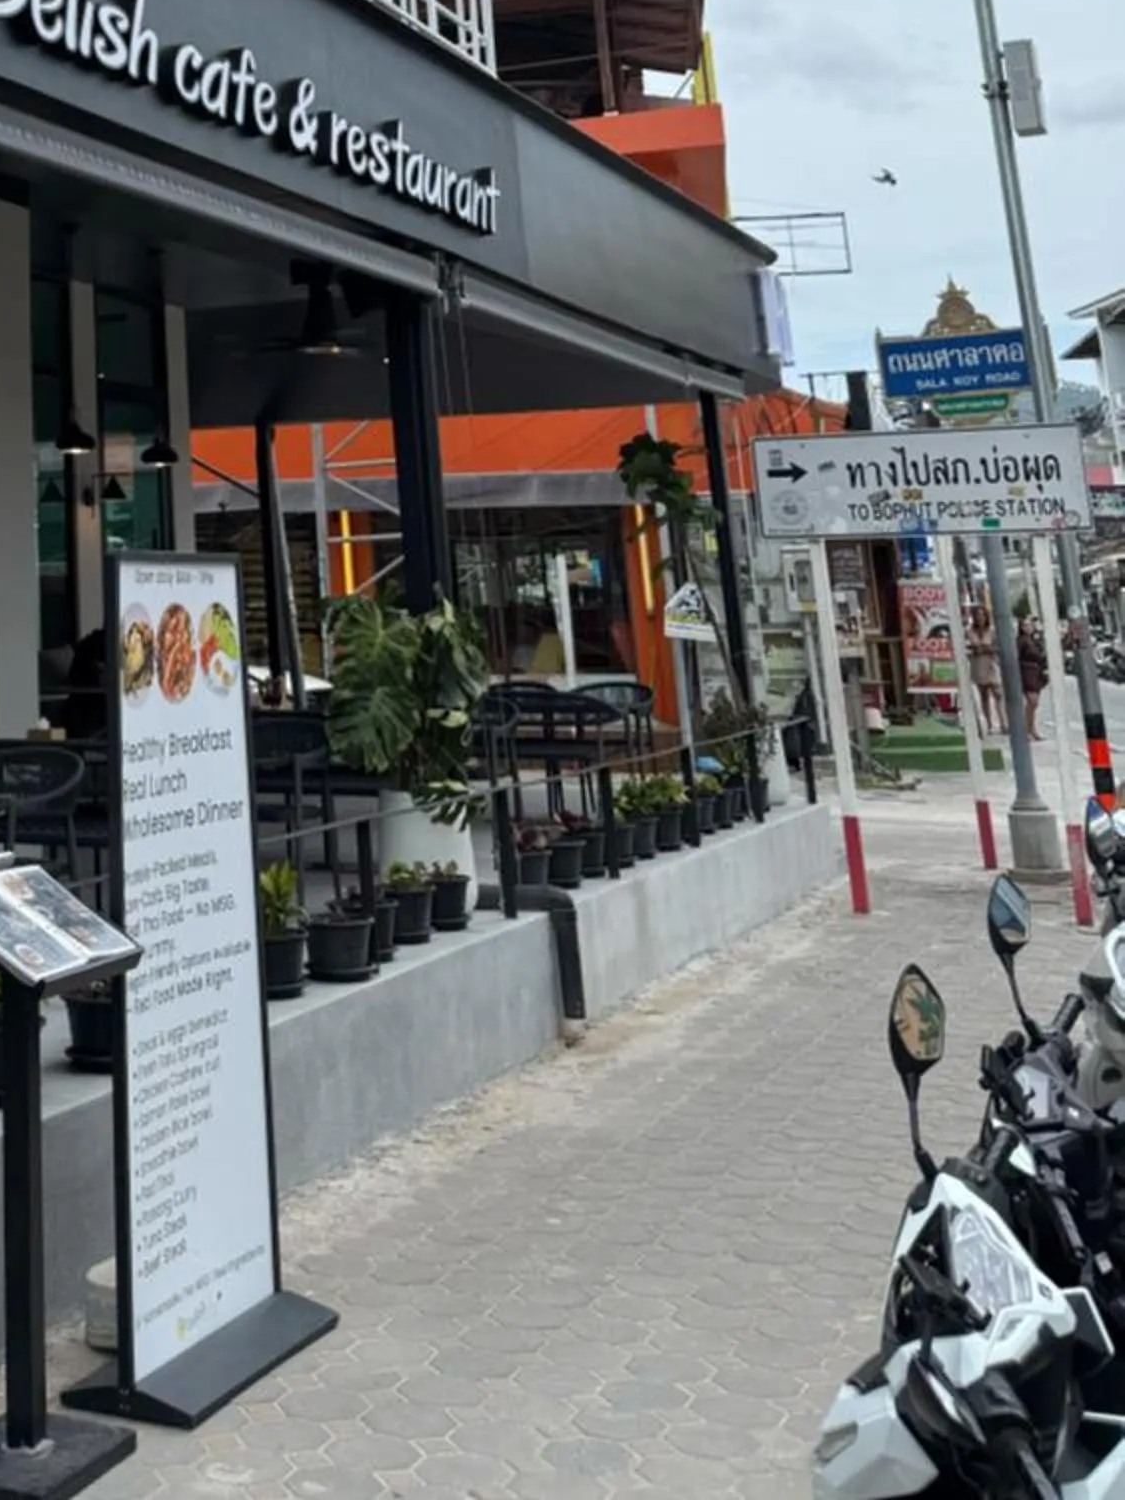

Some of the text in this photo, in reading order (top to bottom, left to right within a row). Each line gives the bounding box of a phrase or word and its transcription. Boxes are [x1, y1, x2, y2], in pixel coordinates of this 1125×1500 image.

[174, 43, 278, 136] cafe
[287, 77, 319, 155] &
[330, 111, 501, 235] restaurant
[888, 342, 1026, 374] ถนนศาลาคอ
[847, 504, 870, 521] TO
[995, 497, 1066, 518] STATION
[169, 729, 233, 759] Breakfast
[149, 769, 187, 798] Lunch
[197, 798, 245, 825] Dinner
